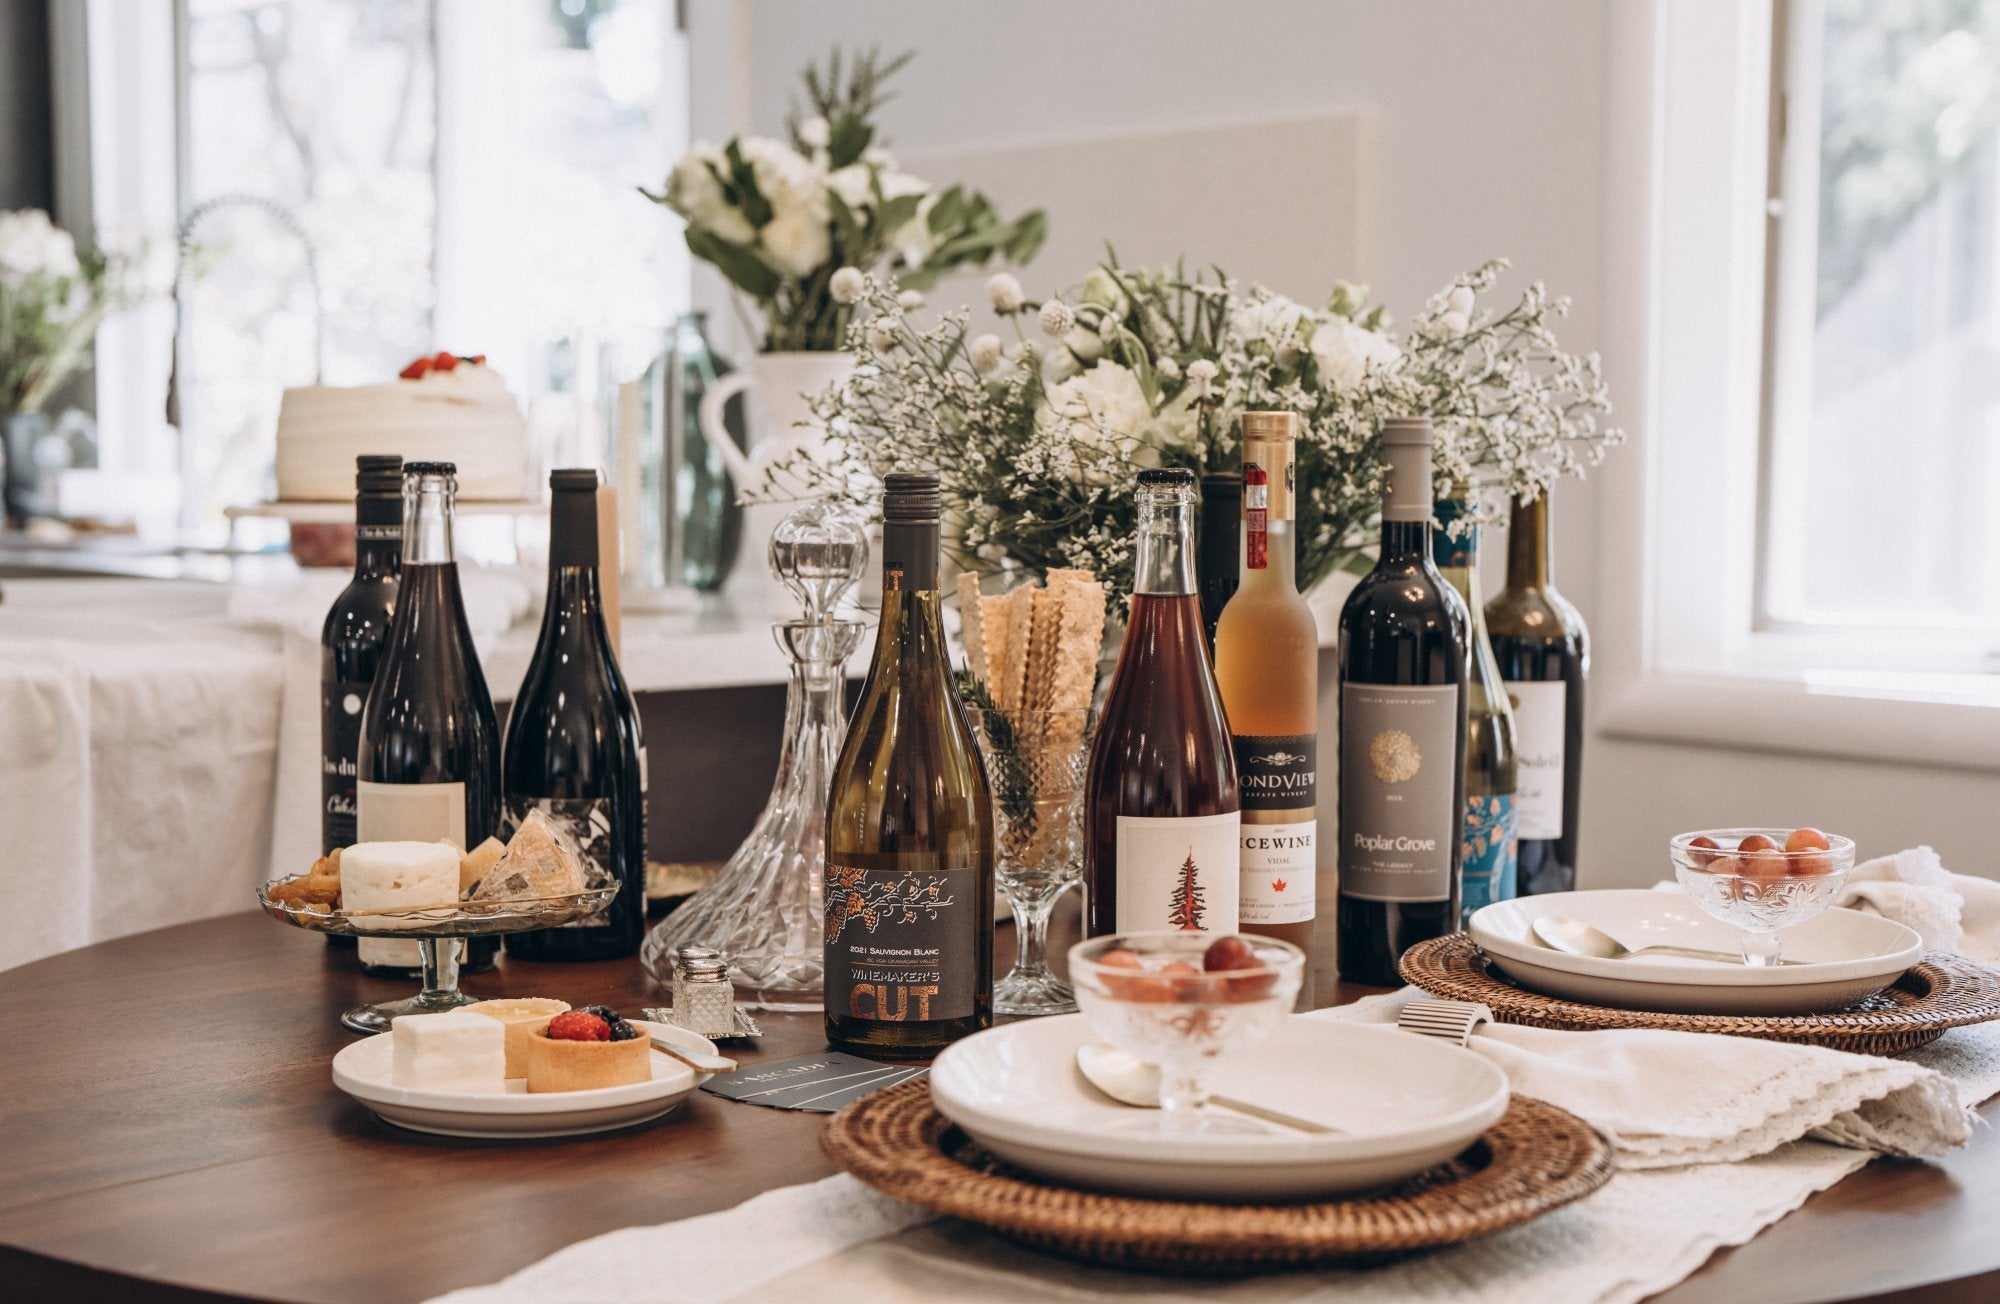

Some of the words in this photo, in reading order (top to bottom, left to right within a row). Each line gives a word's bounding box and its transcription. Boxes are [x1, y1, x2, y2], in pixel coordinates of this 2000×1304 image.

[1240, 771, 1316, 790] ONDVIEW
[1240, 834, 1312, 849] ICEWINE
[1354, 832, 1395, 852] Poplar
[1395, 836, 1436, 852] Grove
[1266, 857, 1292, 865] VIDAL
[849, 945, 867, 954] 2021
[851, 968, 940, 982] WINEMAKER'S
[850, 983, 939, 1022] CUT
